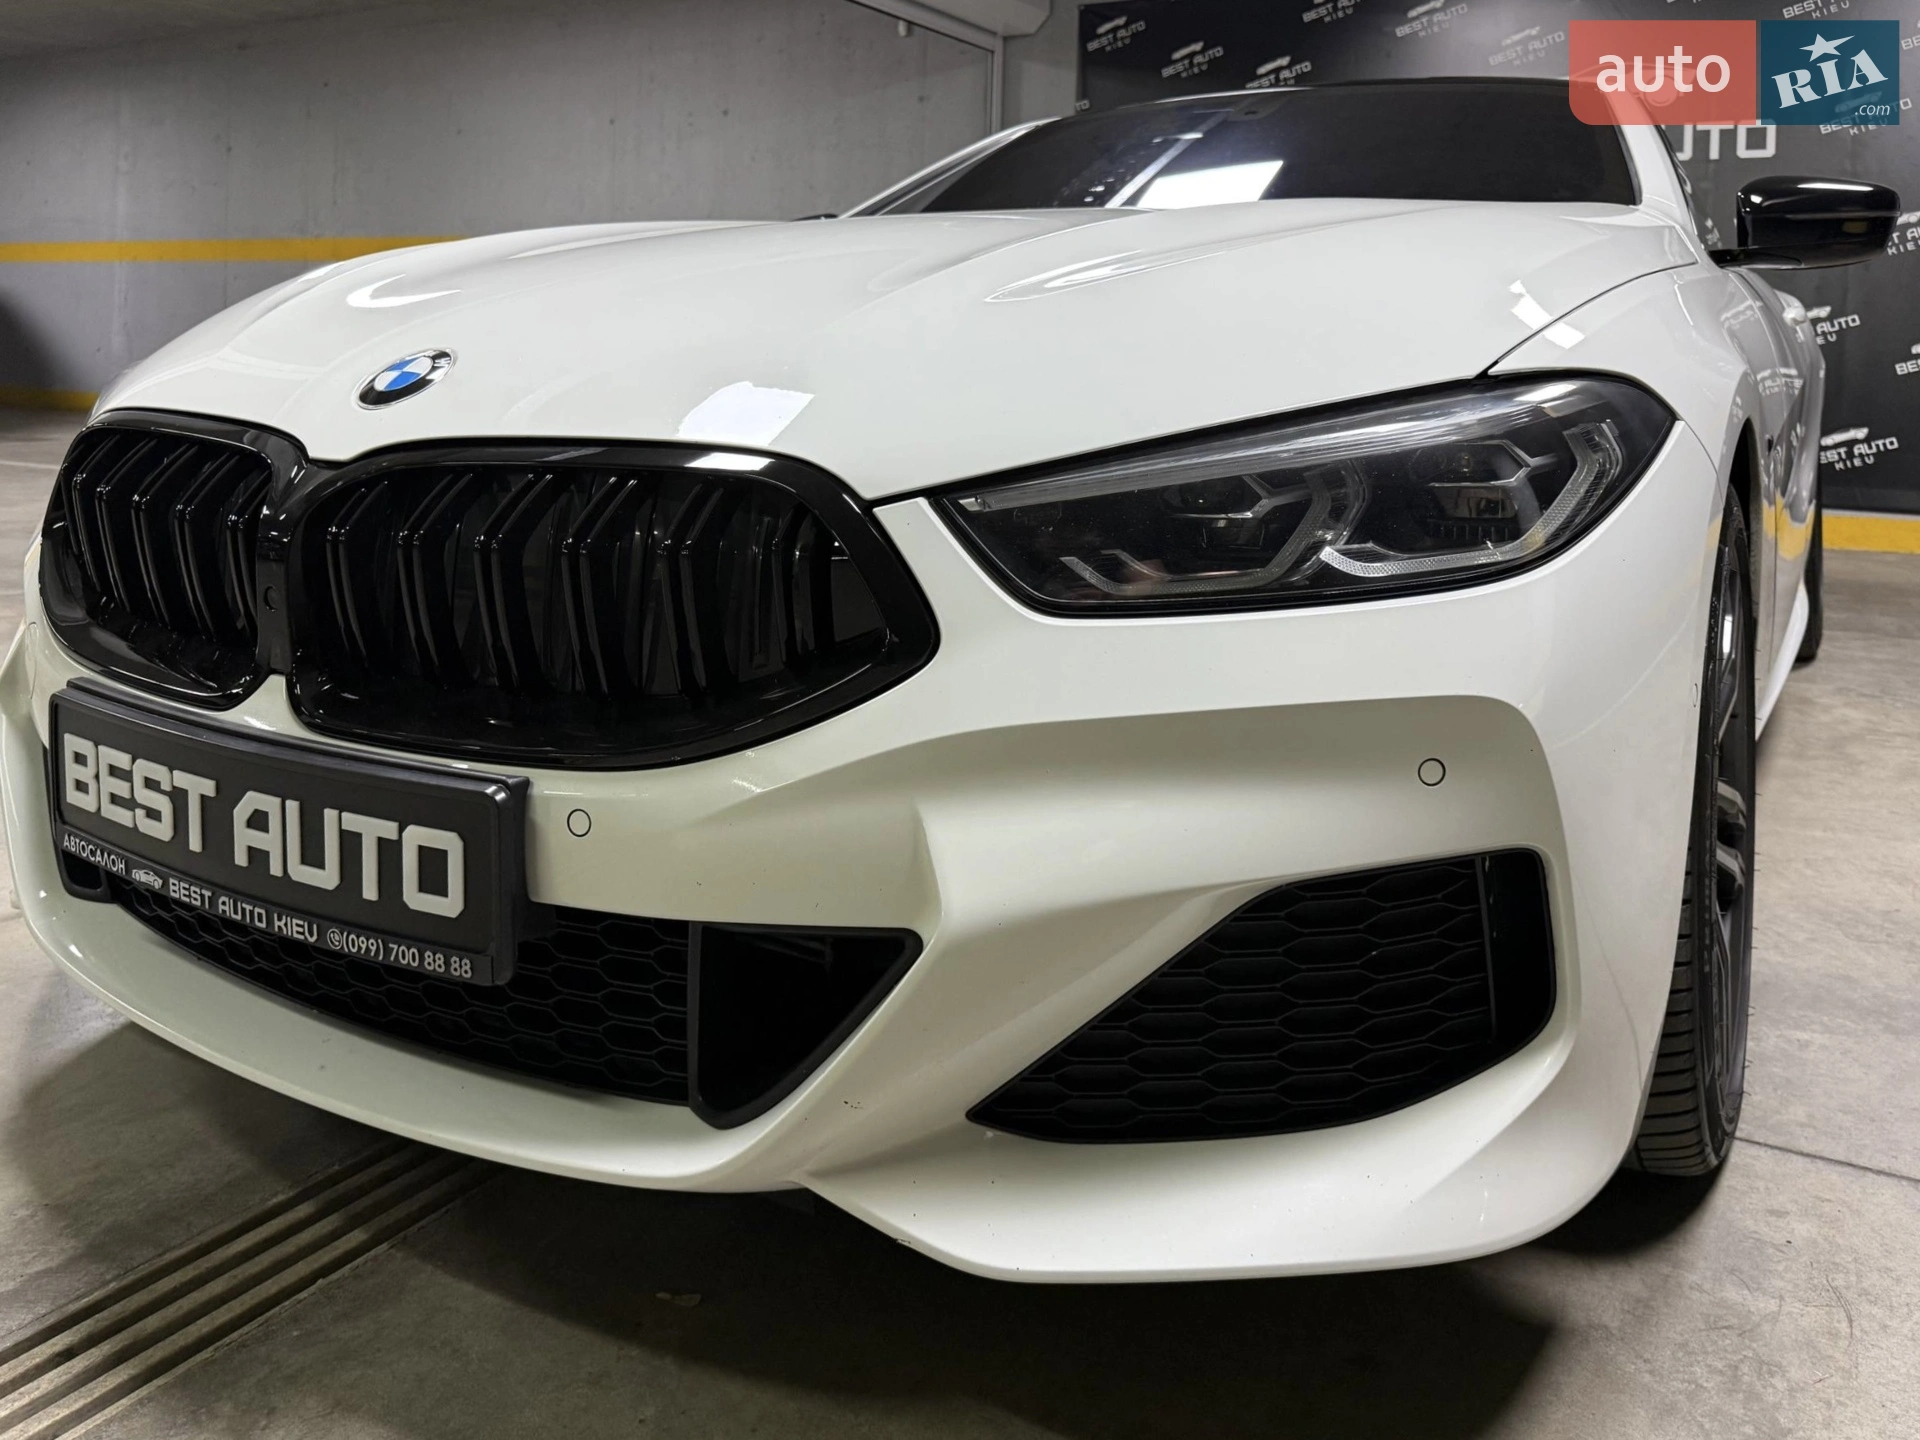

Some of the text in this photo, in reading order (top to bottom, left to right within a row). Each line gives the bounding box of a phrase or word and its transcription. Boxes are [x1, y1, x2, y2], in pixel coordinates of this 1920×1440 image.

[1675, 119, 1777, 161] UTO
[1815, 314, 1861, 335] AUTO
[1819, 436, 1899, 464] EST AUTO
[63, 732, 465, 919] BEST AUTO
[63, 833, 127, 876] АВТОСАЛОН
[169, 877, 213, 910] BEST
[218, 896, 268, 929] AUTO
[342, 931, 385, 961] (099)
[388, 943, 420, 967] 700
[424, 950, 446, 973] 88
[450, 955, 473, 979] 88
